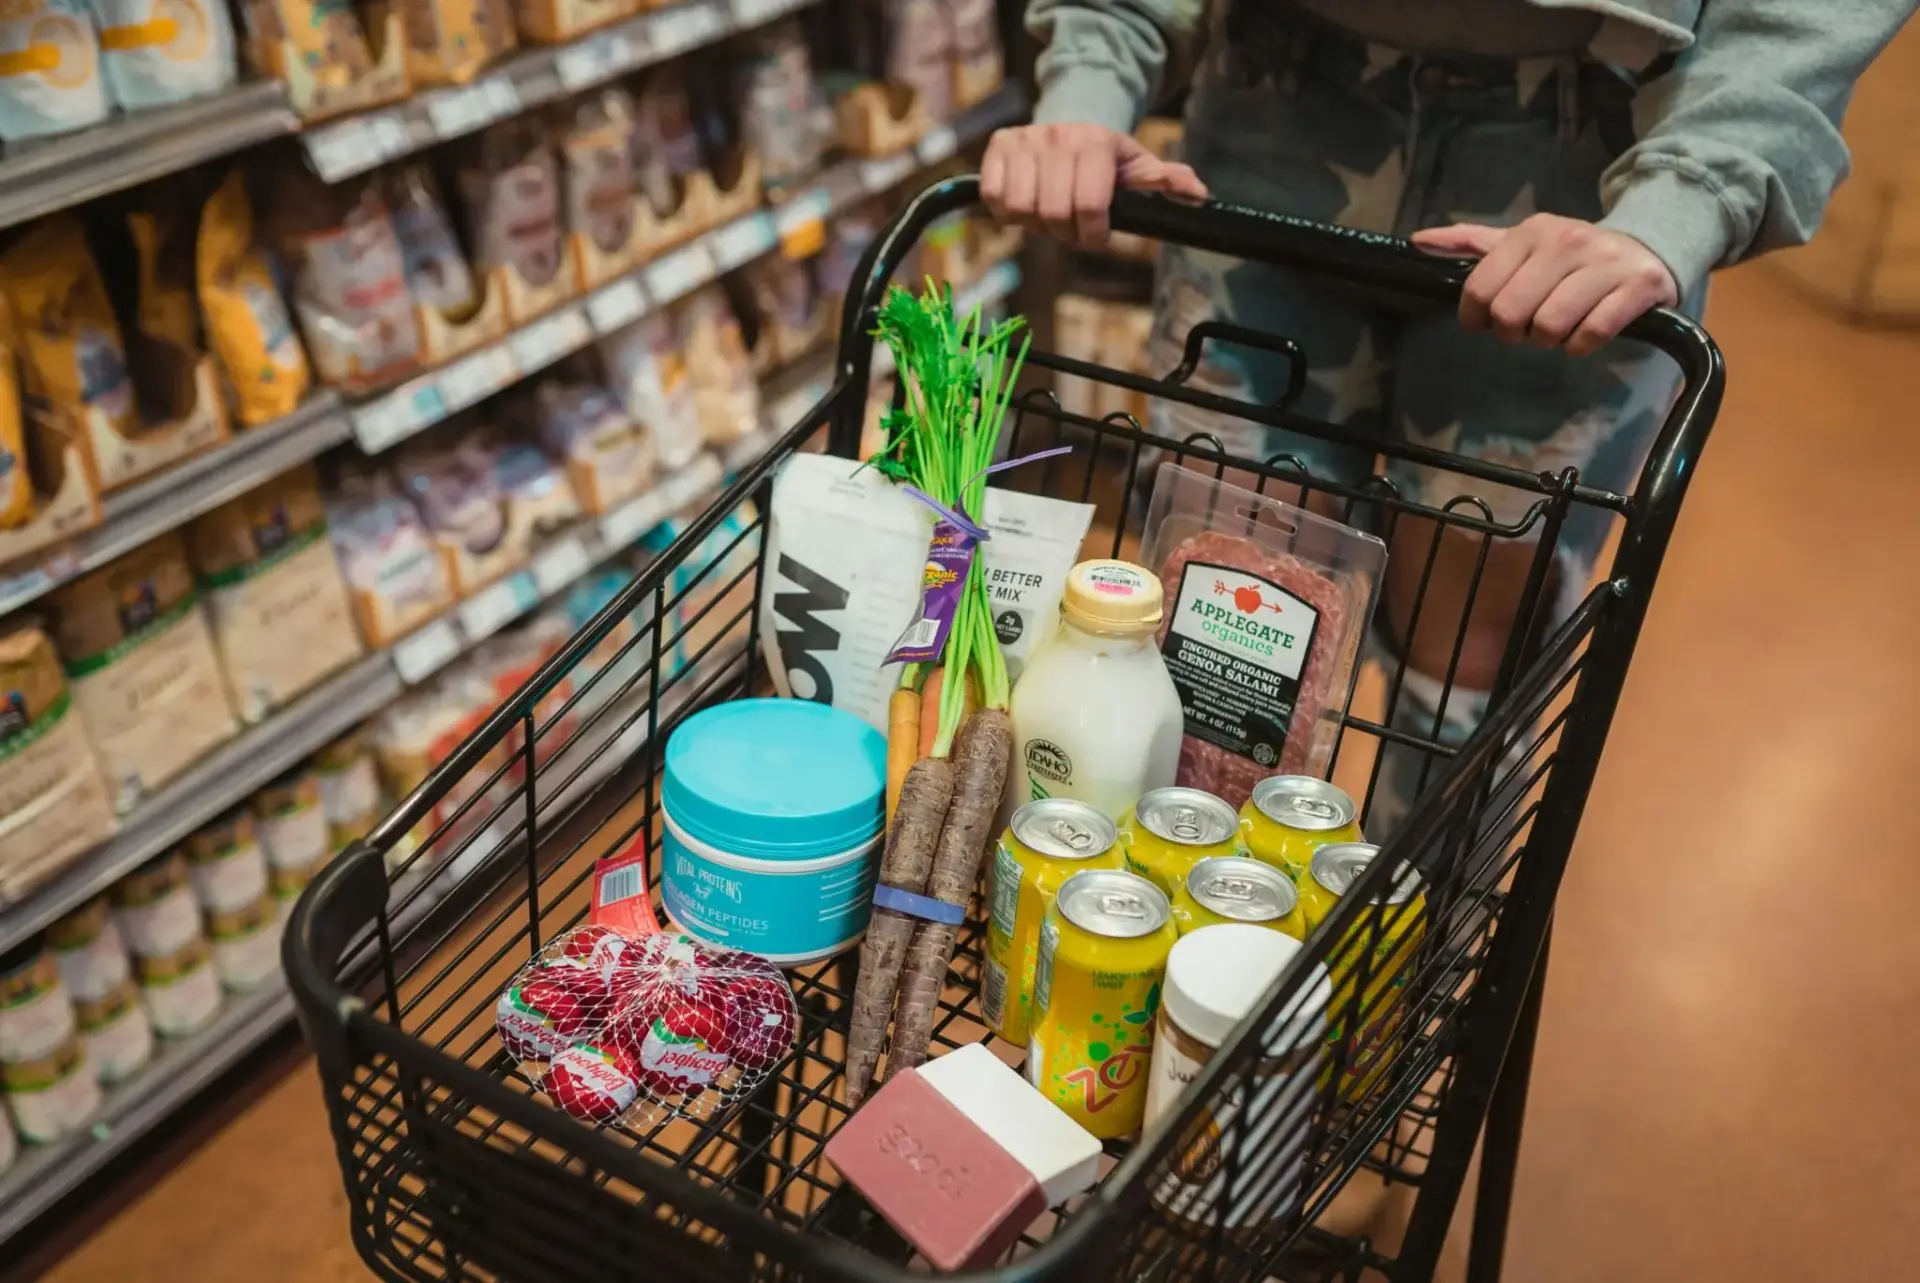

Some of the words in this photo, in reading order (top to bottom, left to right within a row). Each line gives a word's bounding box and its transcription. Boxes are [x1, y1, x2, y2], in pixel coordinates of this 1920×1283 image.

[991, 569, 1043, 588] BETTER
[995, 586, 1022, 602] MIX
[1005, 615, 1016, 626] 2g
[1191, 598, 1295, 649] APPLEGATE
[1201, 620, 1274, 656] organics
[1178, 649, 1222, 676] GENOA
[1225, 668, 1280, 697] SALAMI
[1182, 639, 1232, 666] UNCURED
[1232, 660, 1282, 685] ORGANIC
[1028, 749, 1069, 775] IDAHO
[675, 852, 696, 878] VITAL
[698, 870, 742, 904] PROTEINS
[708, 907, 770, 931] PEPTIDES
[564, 1052, 626, 1092] Babybel
